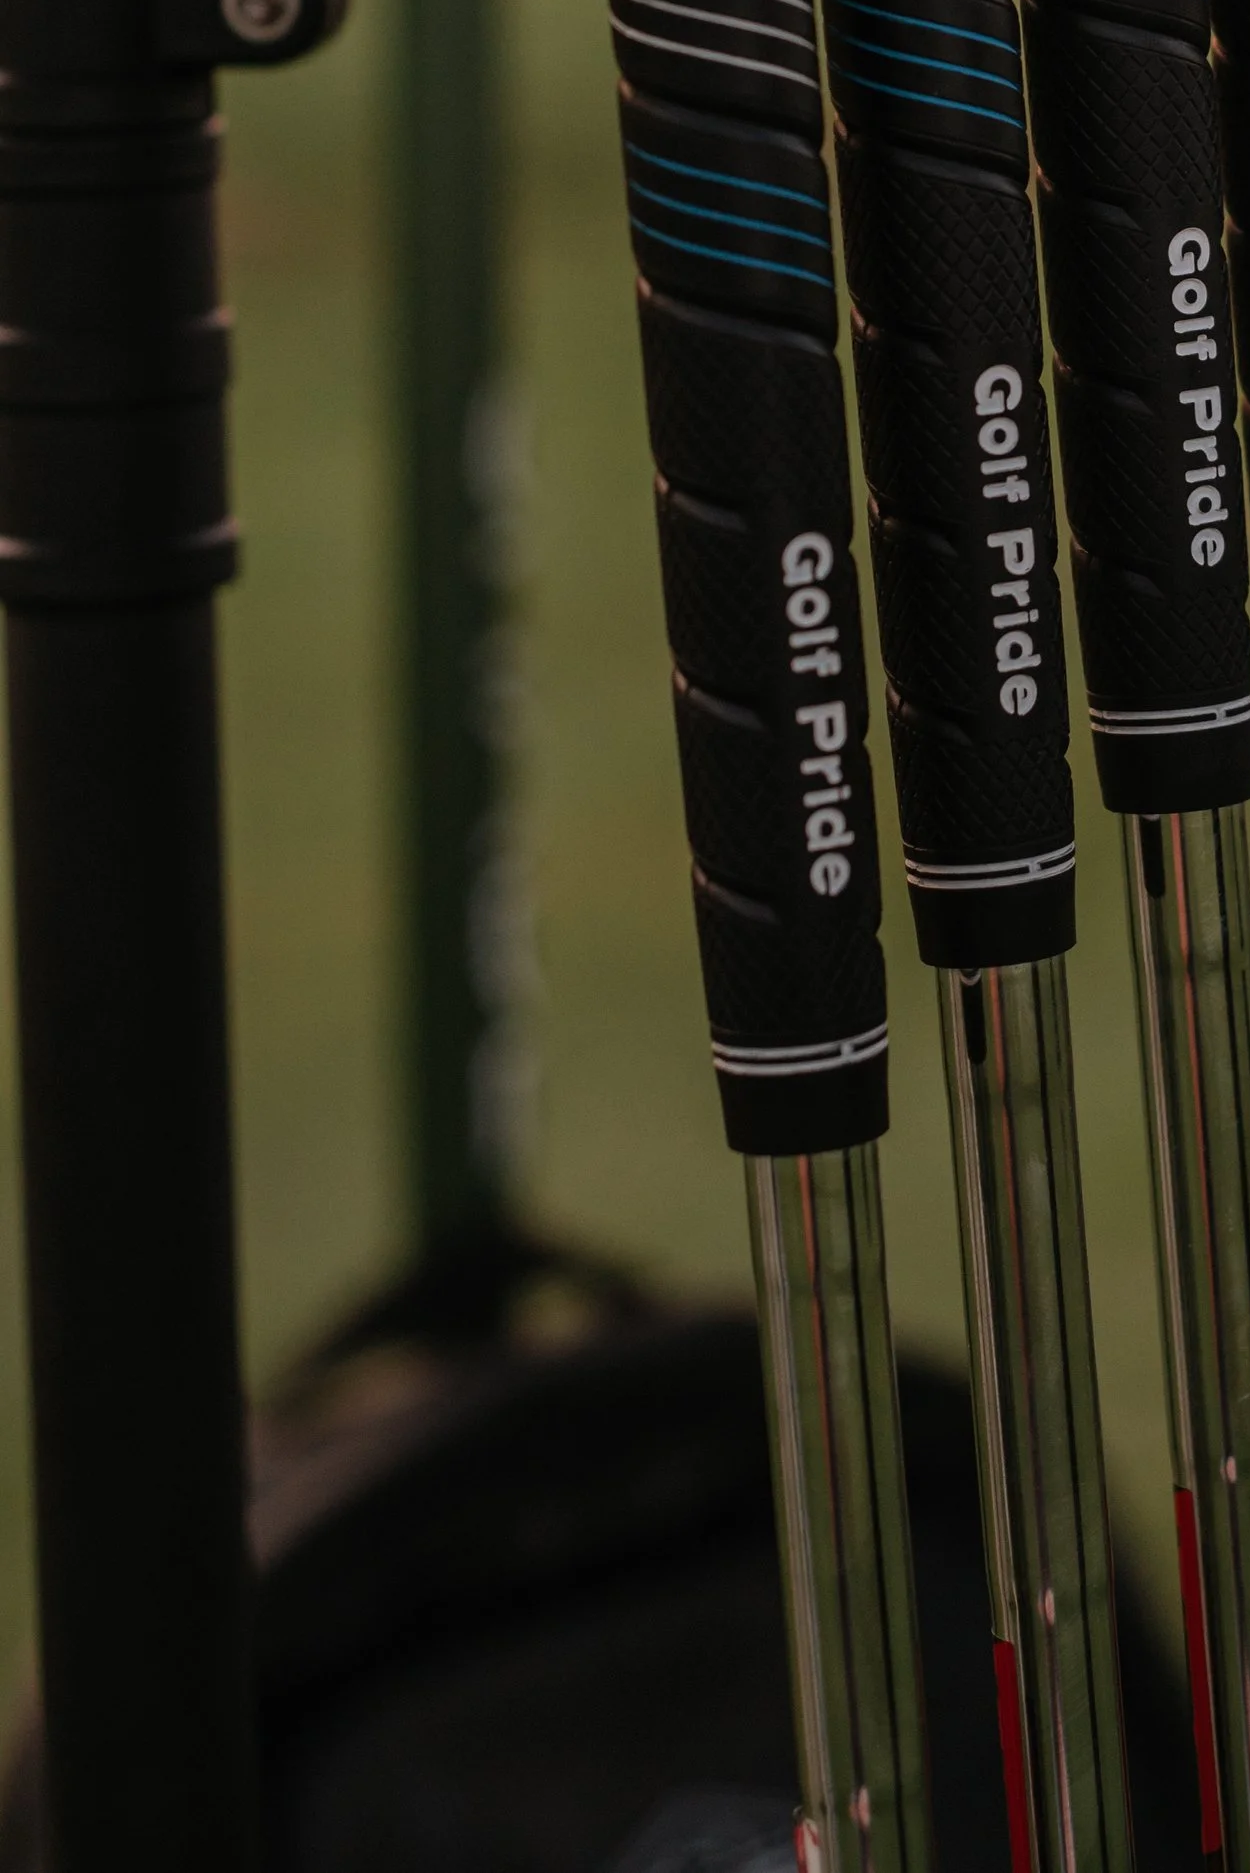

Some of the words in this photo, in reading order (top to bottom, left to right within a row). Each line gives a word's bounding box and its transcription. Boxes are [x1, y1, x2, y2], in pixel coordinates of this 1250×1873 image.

[1167, 227, 1218, 361] Golf
[974, 364, 1030, 503] Golf
[1178, 385, 1229, 567] Pride
[782, 533, 841, 677] Golf
[986, 527, 1042, 716] Pride
[796, 702, 855, 896] Pride
